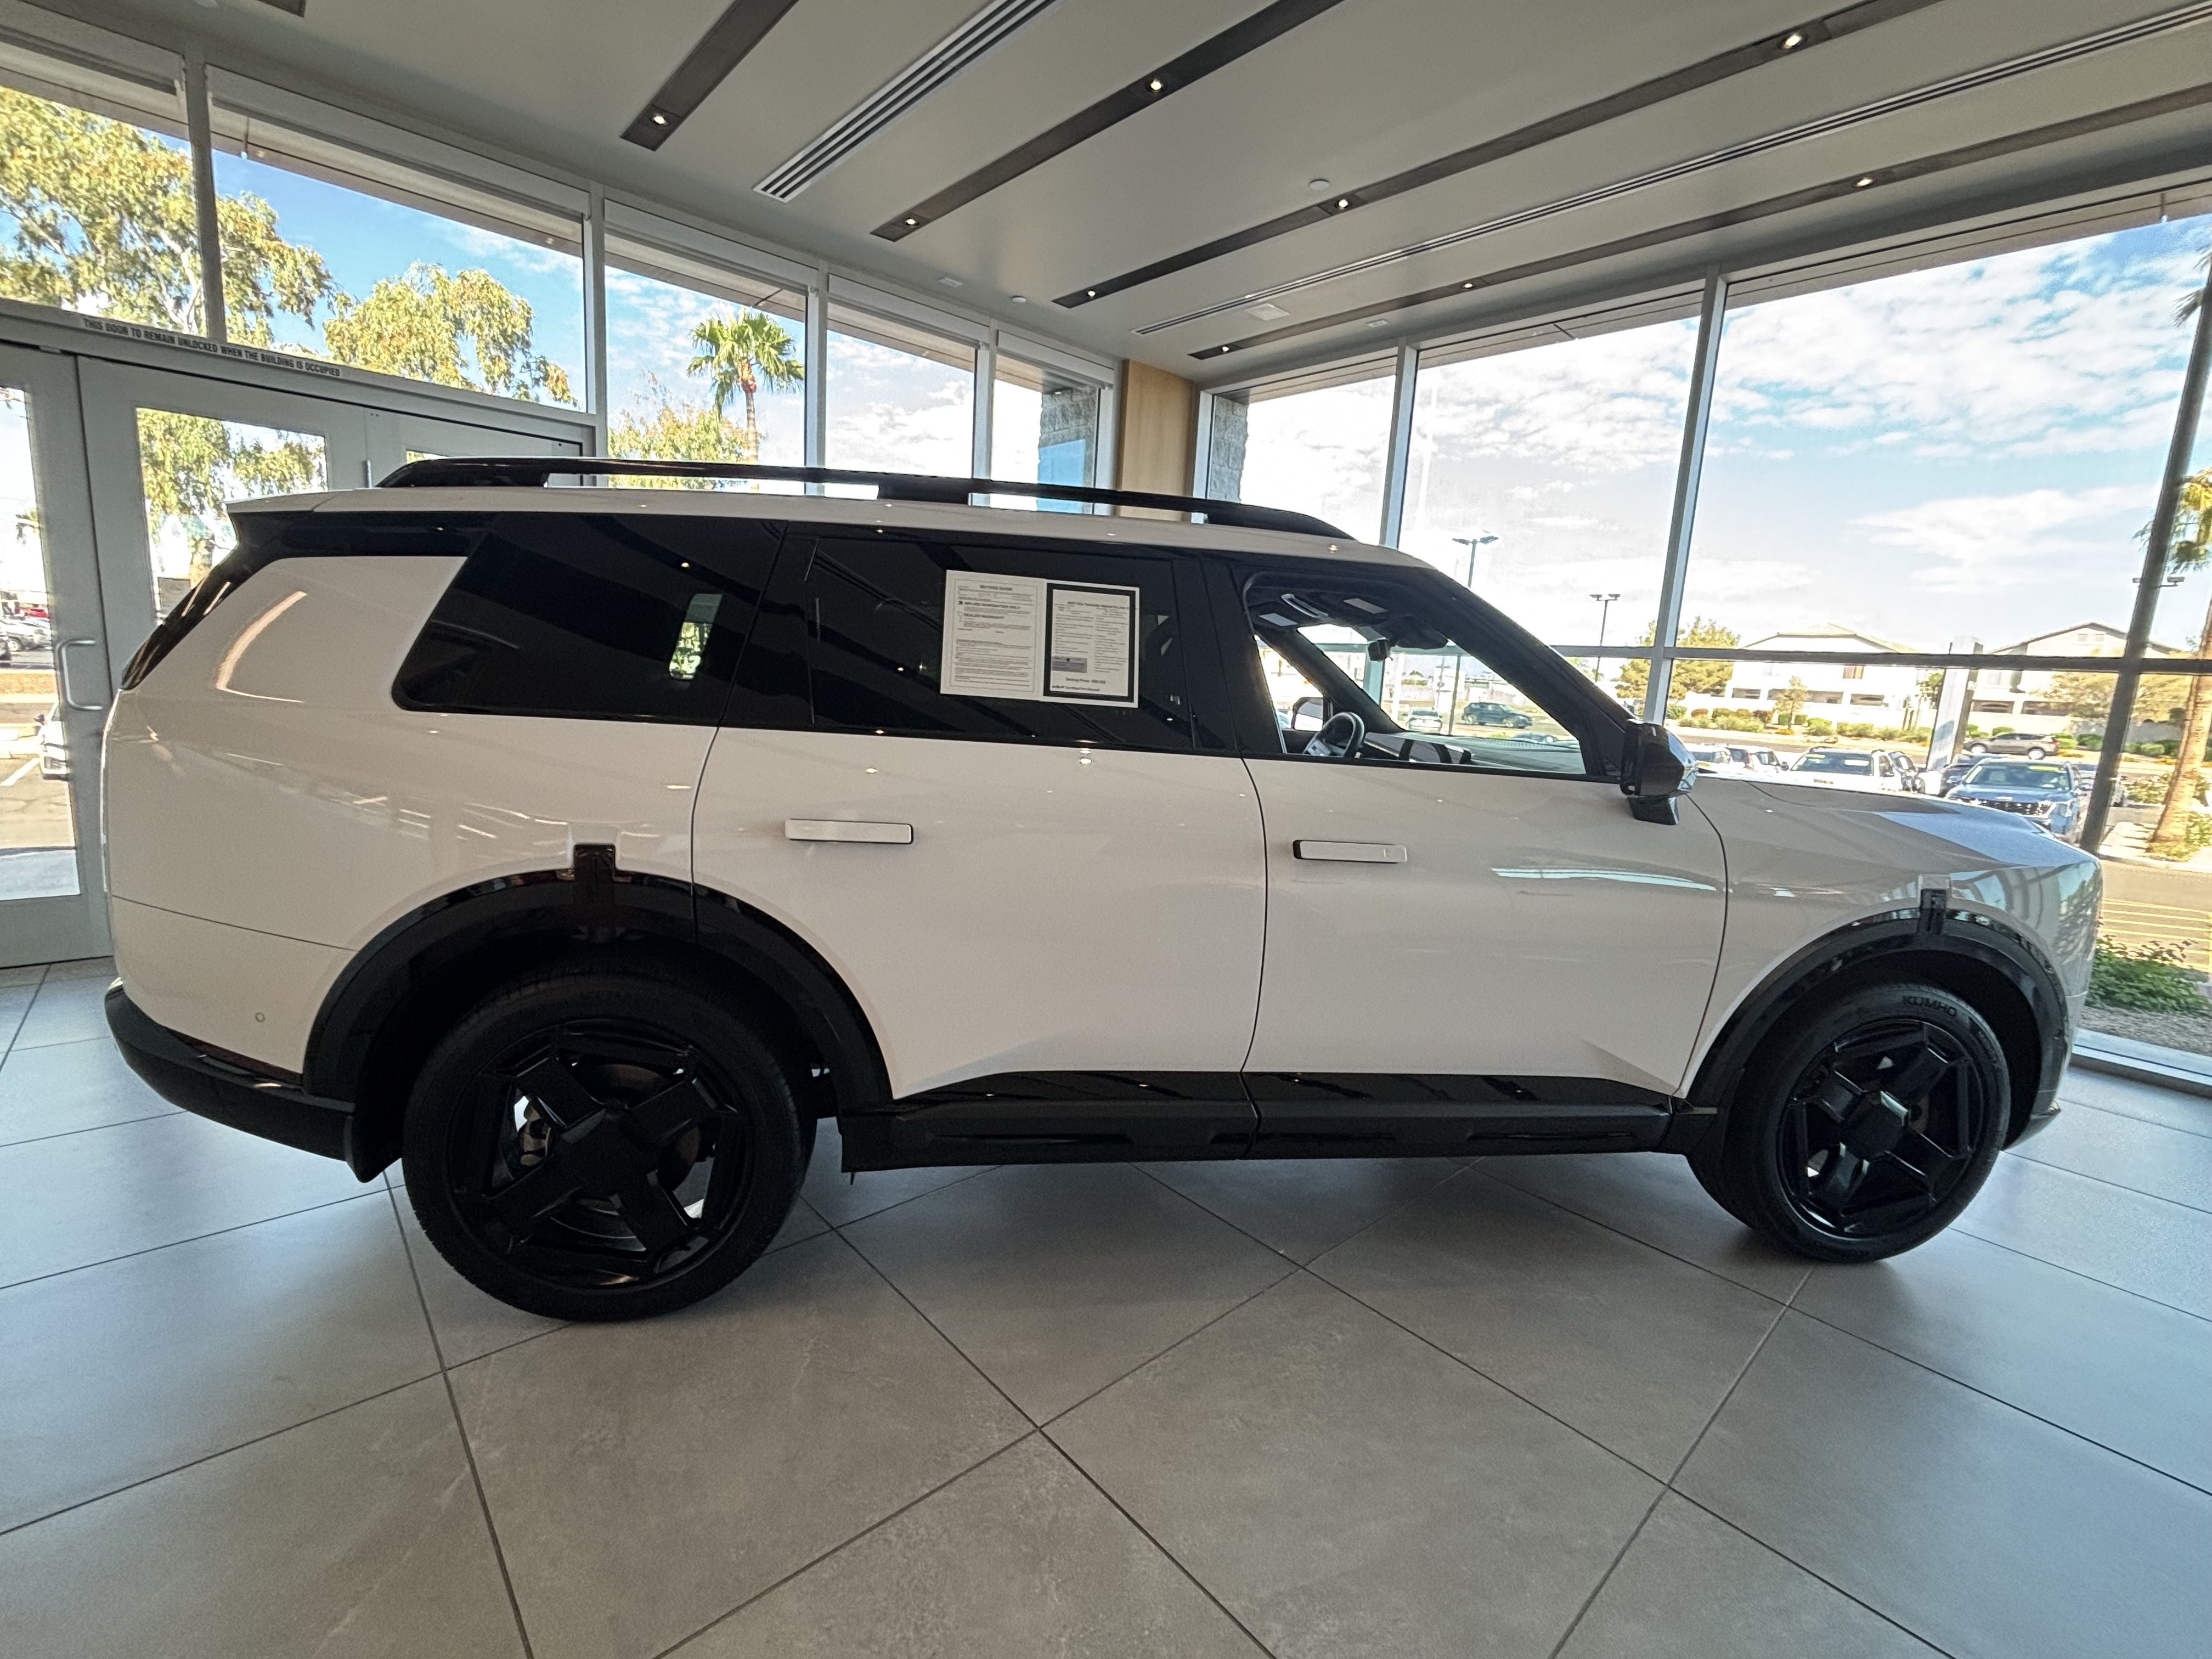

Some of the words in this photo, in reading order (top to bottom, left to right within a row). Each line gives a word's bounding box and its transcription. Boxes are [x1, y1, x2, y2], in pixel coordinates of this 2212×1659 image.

[83, 318, 103, 330] THIS
[105, 323, 129, 336] DOOR
[131, 328, 142, 338] TO
[144, 330, 176, 345] REMAIN
[177, 336, 218, 353] UNLOCKED
[221, 346, 242, 358] WHEN
[245, 351, 258, 361] THE
[261, 353, 295, 368] BUILDING
[296, 360, 304, 370] IS
[305, 362, 340, 377] OCCUPIED
[1902, 995, 1958, 1017] KUMHO
